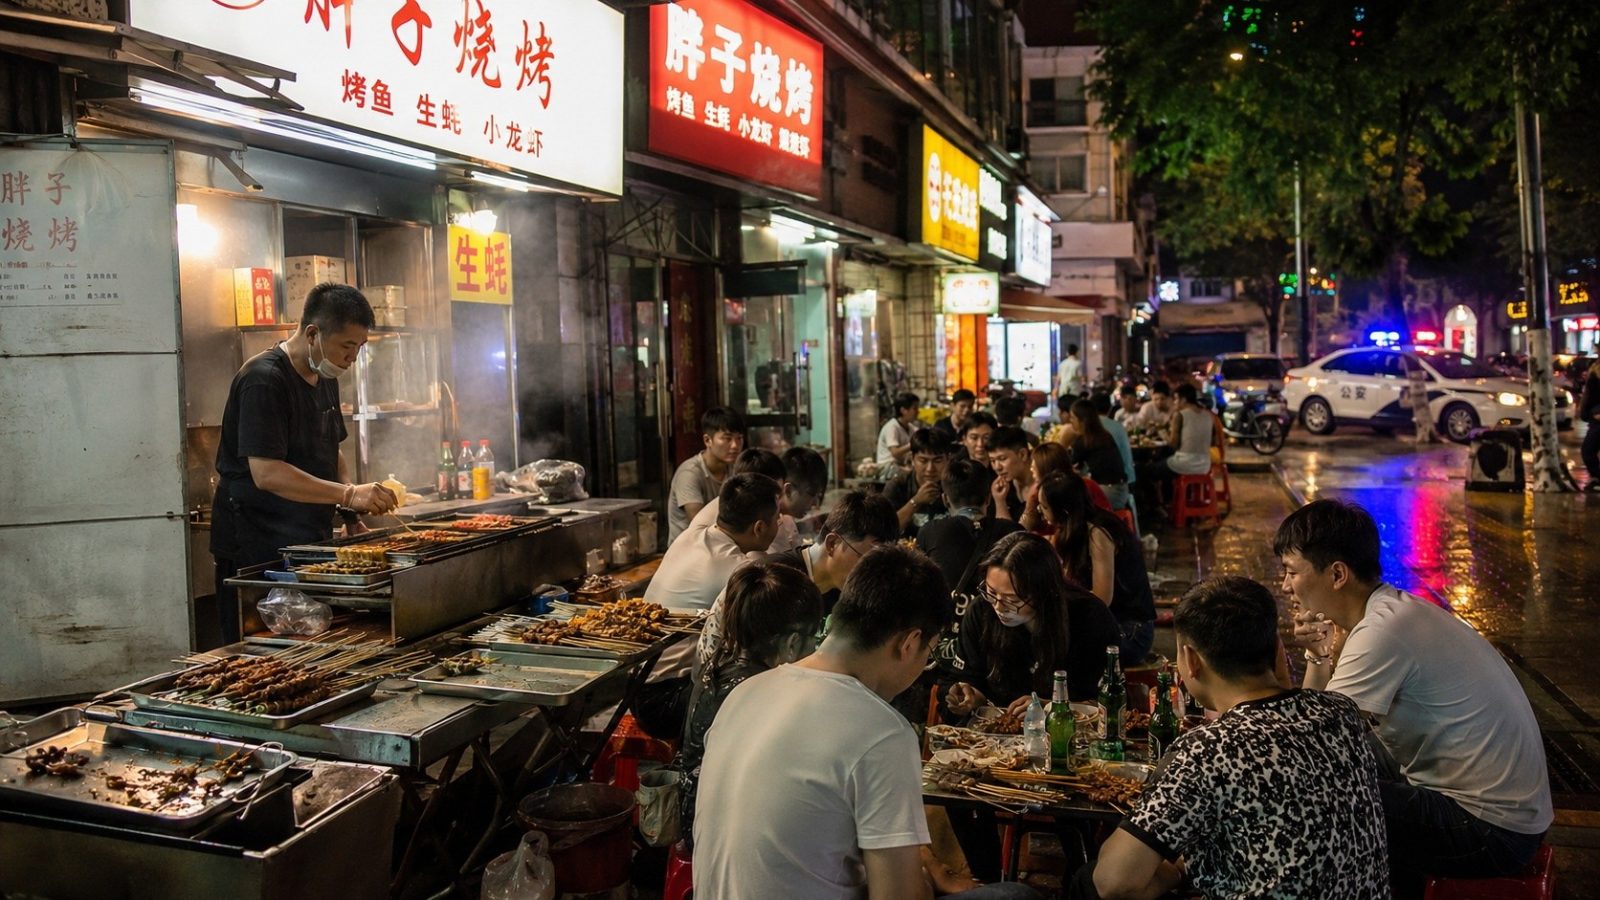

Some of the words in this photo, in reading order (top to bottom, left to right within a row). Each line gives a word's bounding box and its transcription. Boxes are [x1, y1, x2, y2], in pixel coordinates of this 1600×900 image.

[665, 2, 814, 125] 胖子烧烤
[341, 69, 394, 116] 烤鱼
[416, 93, 461, 135] 生蚝
[483, 114, 544, 158] 小龙虾
[666, 86, 695, 120] 烤鱼
[2, 170, 72, 206] 胖子
[2, 216, 79, 252] 烧烤
[455, 233, 507, 295] 生蚝
[1340, 385, 1367, 400] 公安
